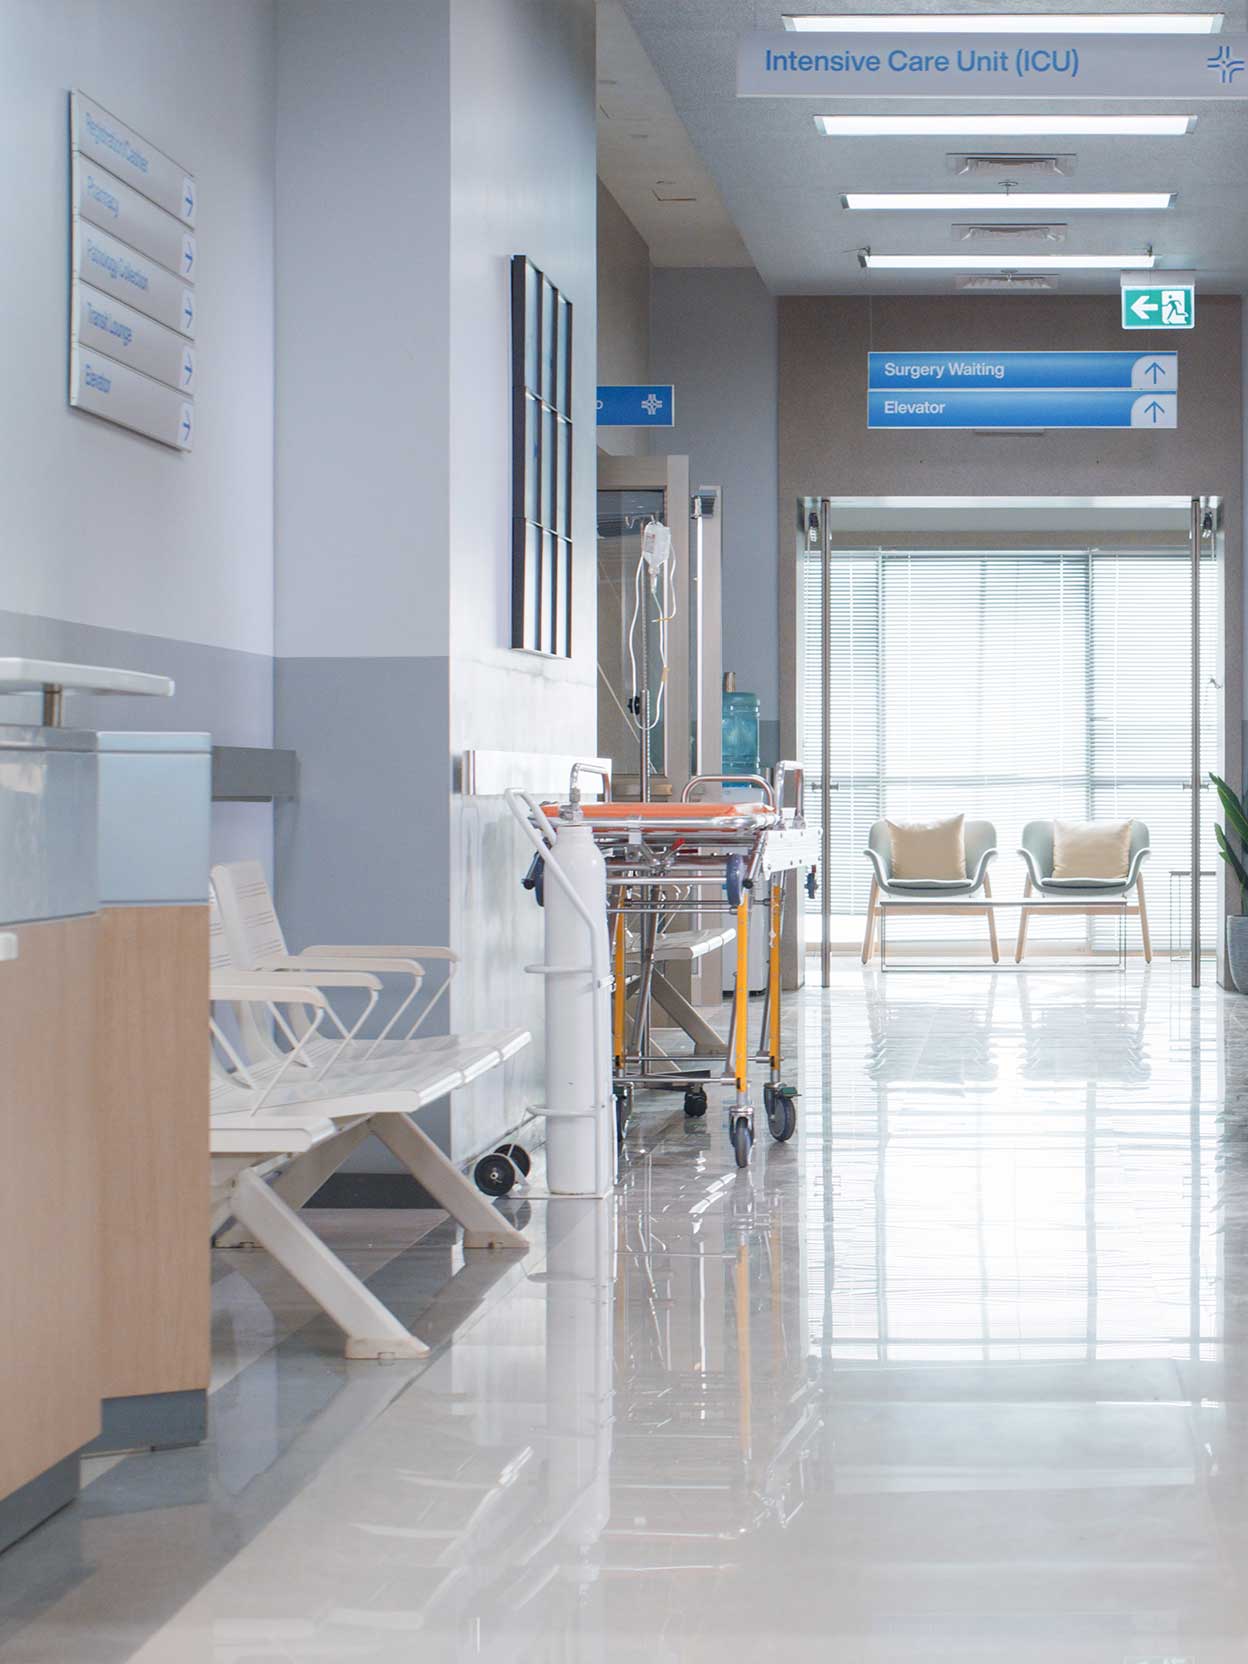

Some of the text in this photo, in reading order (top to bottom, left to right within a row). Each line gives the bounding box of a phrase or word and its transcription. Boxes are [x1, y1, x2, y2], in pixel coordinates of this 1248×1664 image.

[765, 48, 1080, 78] Intensive Care Unit (ICU)
[884, 362, 1005, 379] Surgery Waiting
[884, 400, 946, 414] Elevator
